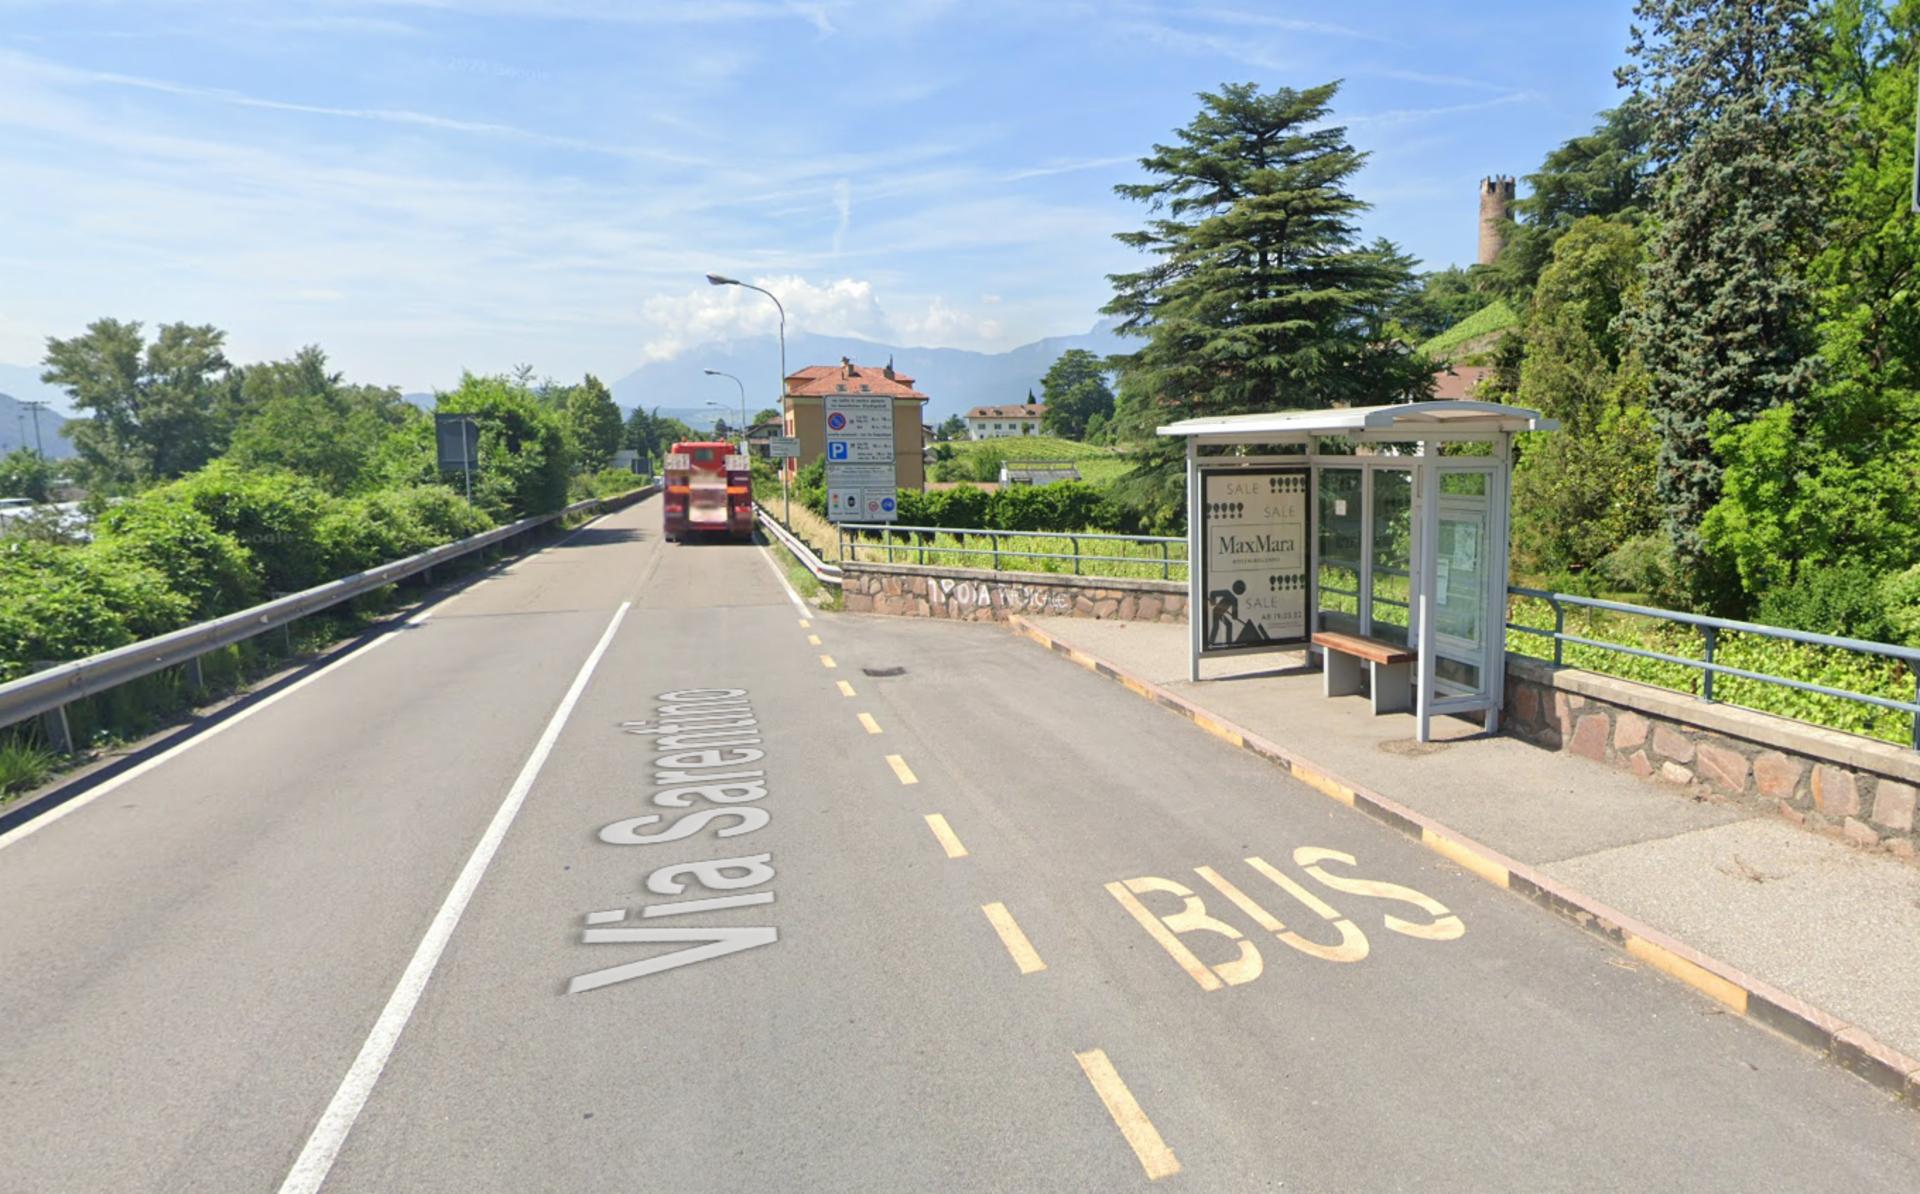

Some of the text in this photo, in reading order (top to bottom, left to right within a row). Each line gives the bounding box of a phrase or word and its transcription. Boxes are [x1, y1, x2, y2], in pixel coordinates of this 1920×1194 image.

[1226, 482, 1260, 496] SALE
[1263, 505, 1297, 519] SALE
[1218, 534, 1295, 555] MaxMara
[1245, 596, 1279, 609] SALE
[1103, 846, 1466, 992] BUS
